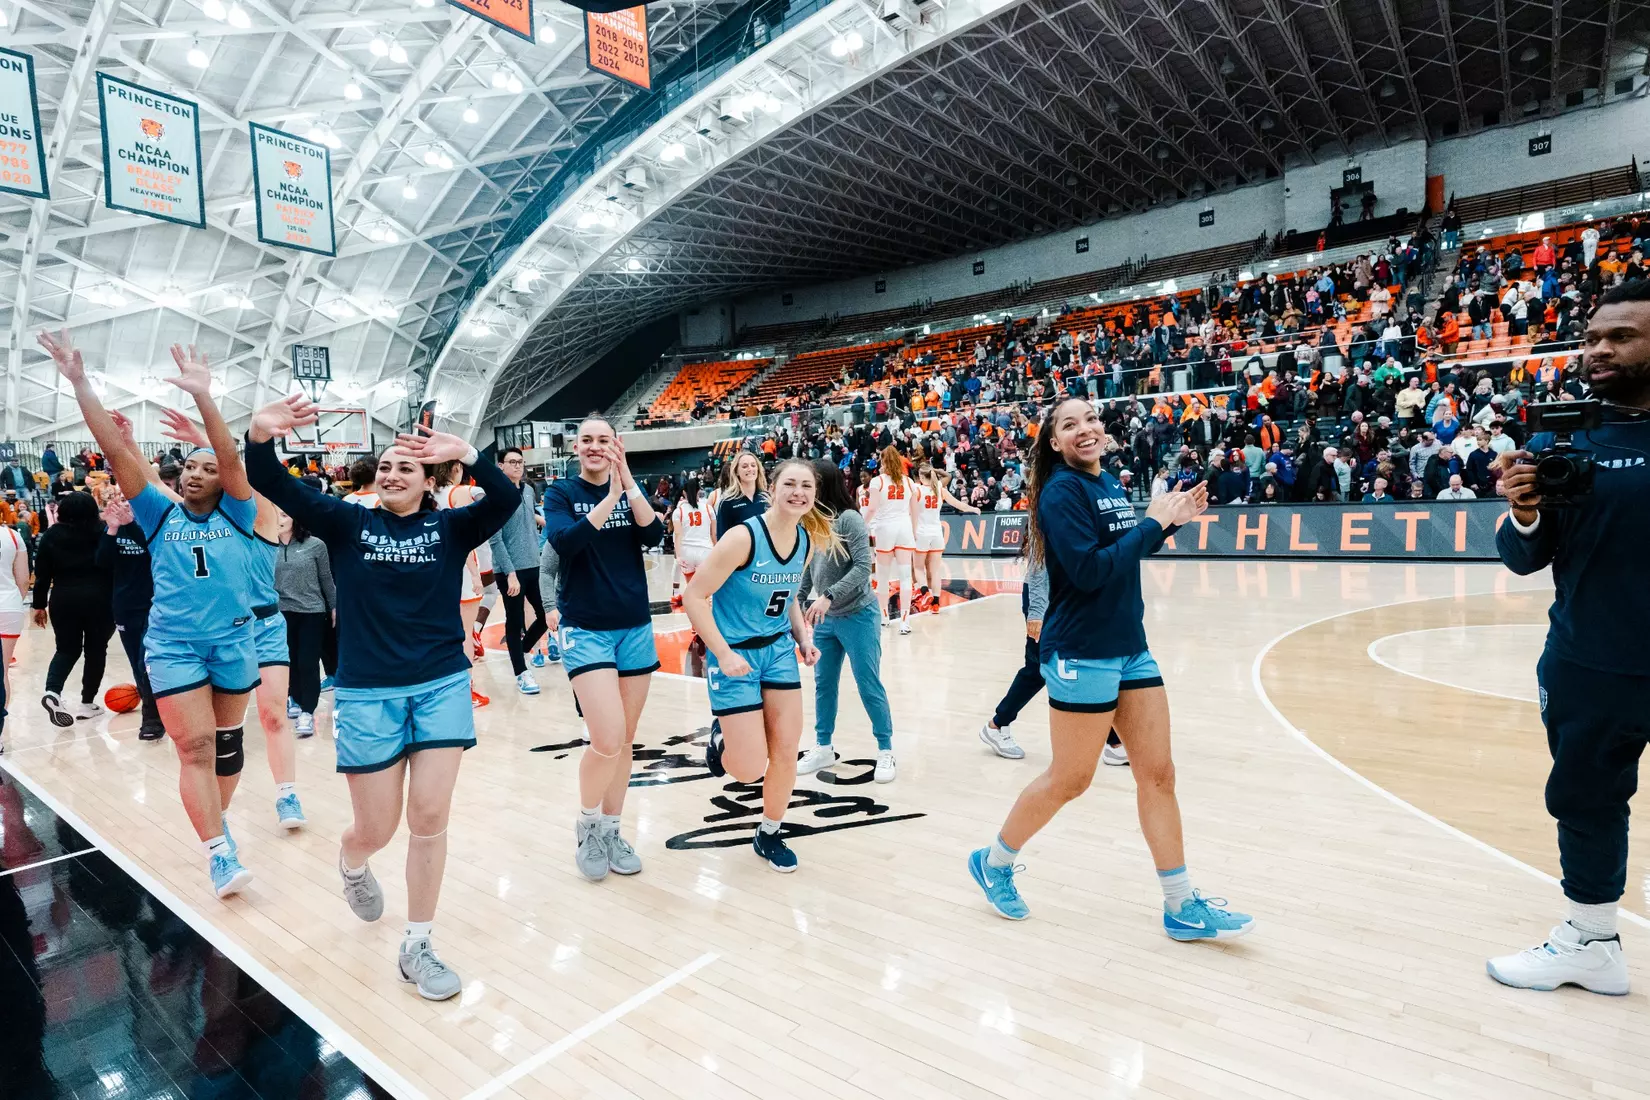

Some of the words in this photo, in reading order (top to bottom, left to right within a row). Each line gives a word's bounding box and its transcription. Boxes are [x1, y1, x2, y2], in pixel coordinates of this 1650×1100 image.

[595, 25, 618, 42] 2018
[622, 37, 644, 54] 2019
[597, 39, 619, 57] 2022
[624, 51, 645, 68] 2023
[598, 54, 620, 71] 2024
[107, 84, 191, 119] PRINCETON
[135, 141, 172, 160] NCAA
[258, 133, 324, 160] PRINCETON
[1532, 141, 1550, 152] 307
[118, 148, 190, 176] CHAMPION
[1345, 172, 1360, 182] 306
[129, 186, 183, 204] HEAVYWEIGHT
[280, 182, 309, 197] NCAA
[266, 189, 324, 211] CHAMPION
[1201, 214, 1213, 223] 305
[887, 484, 905, 500] 22
[924, 495, 938, 509] 32
[688, 511, 702, 527] 13
[1000, 517, 1022, 526] HOME
[164, 527, 232, 542] COLUMBIA
[360, 529, 441, 548] COLUMBIA
[1002, 530, 1020, 544] 60
[190, 544, 210, 579] 1
[363, 552, 437, 563] BASKETBALL
[764, 589, 791, 619] 5
